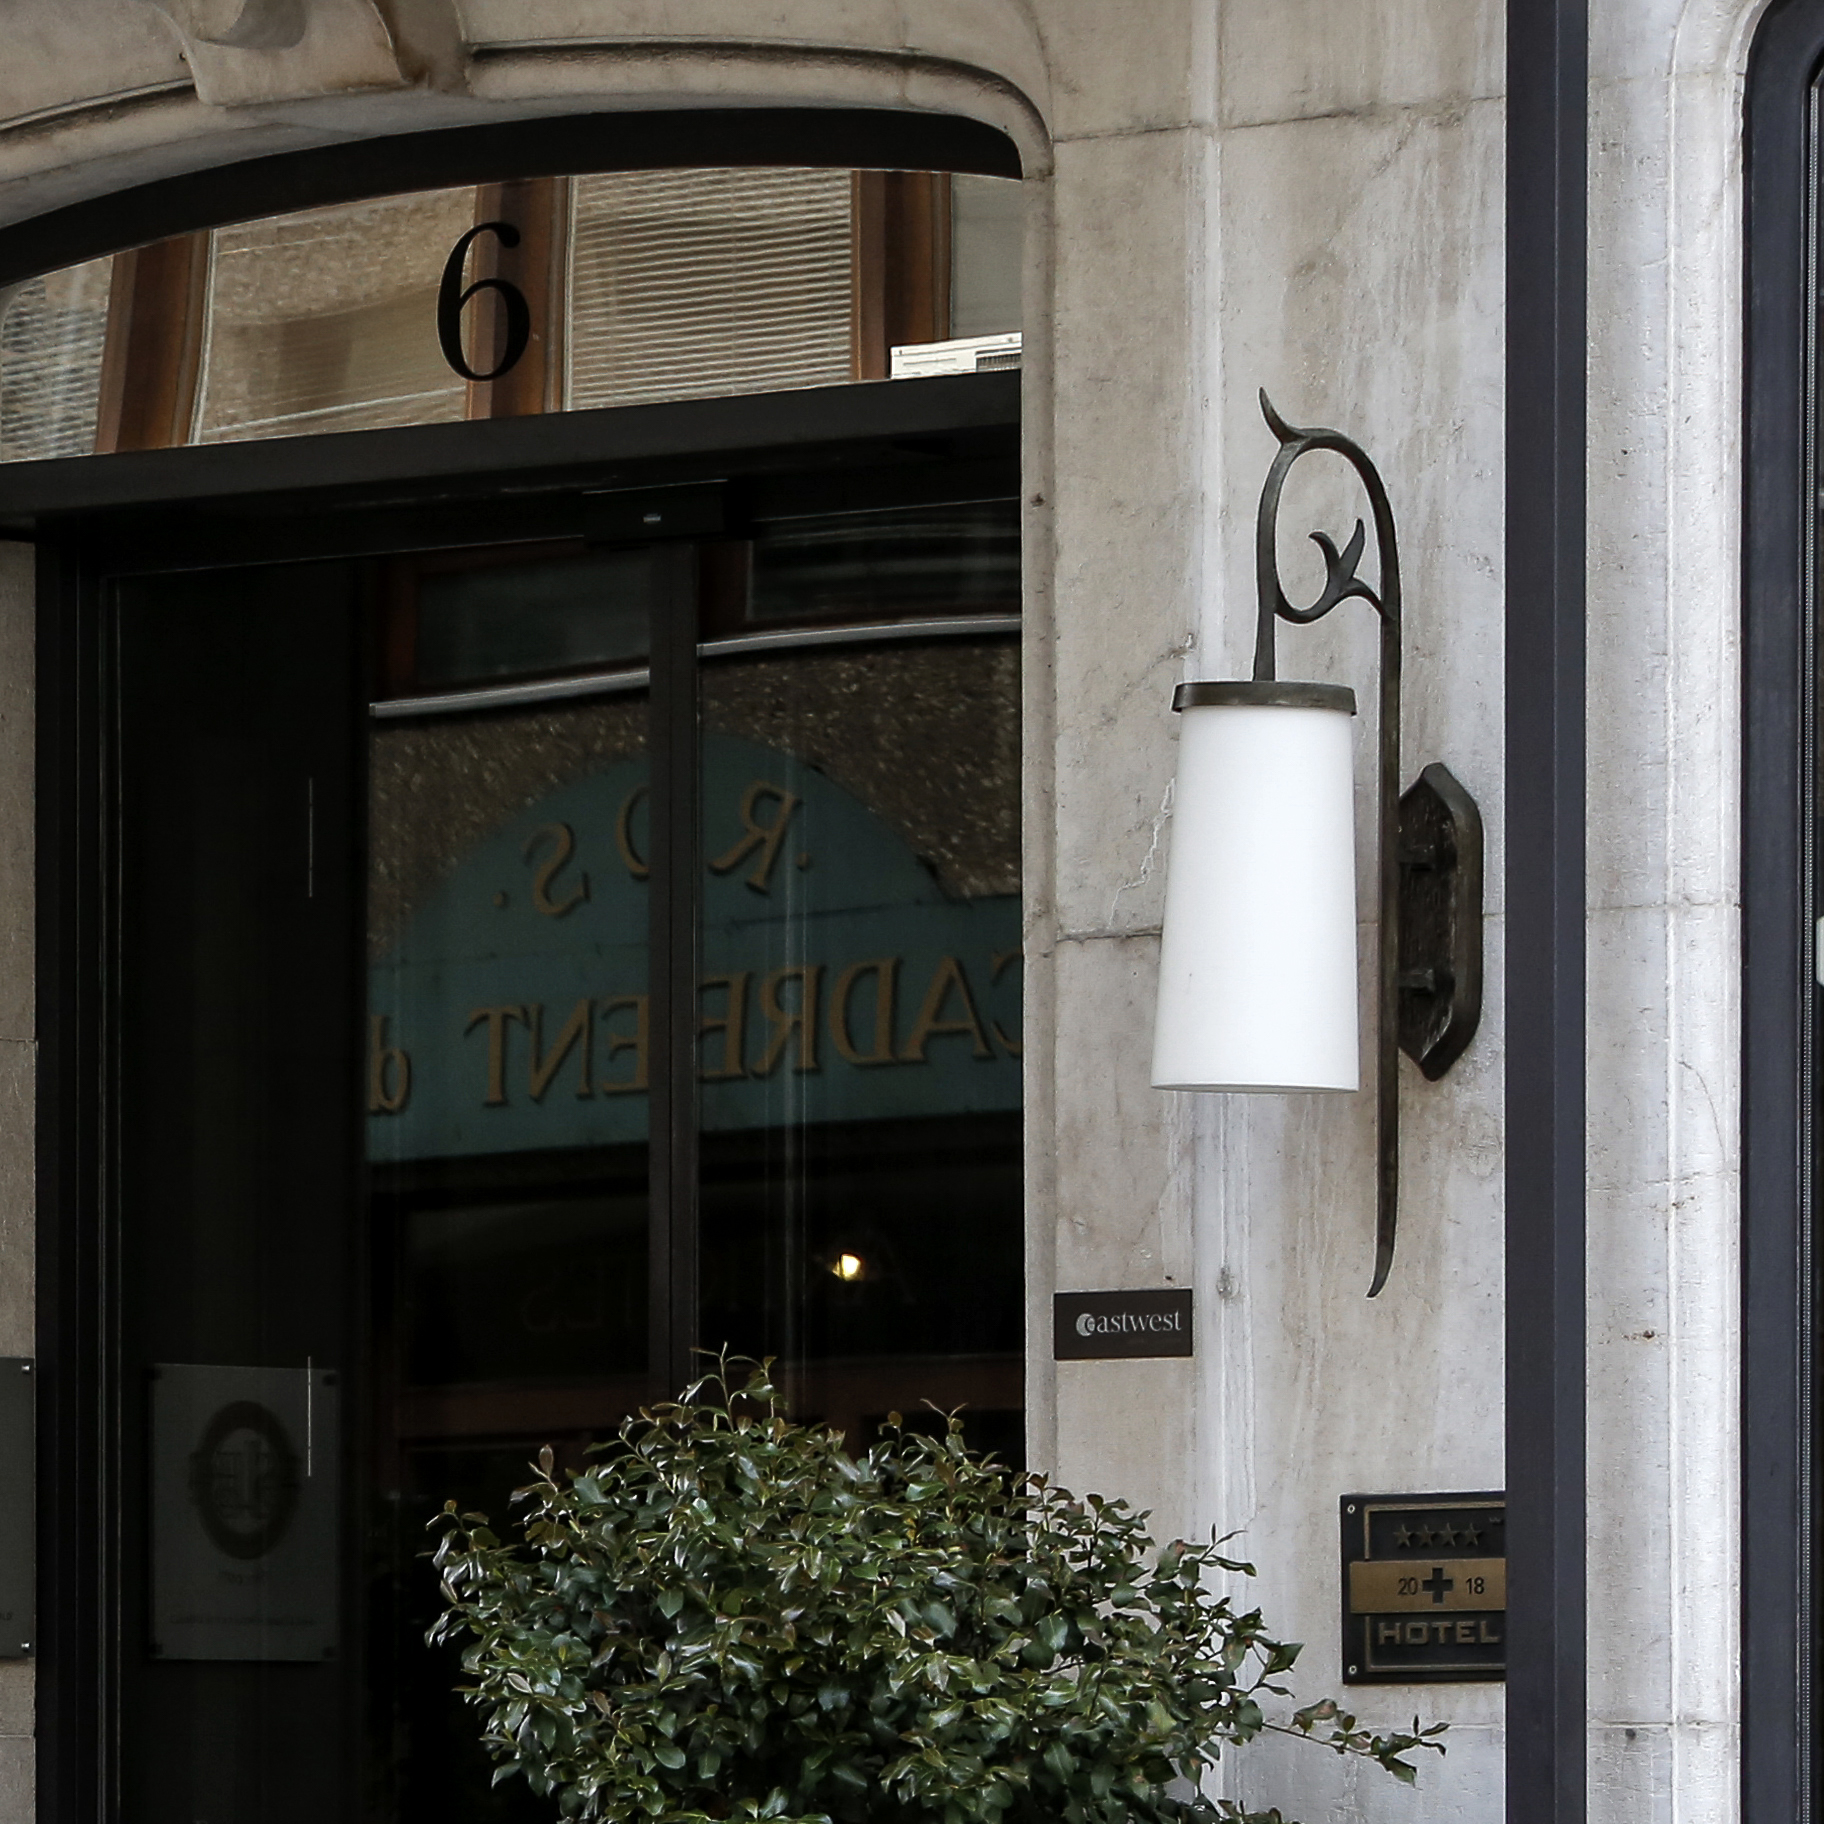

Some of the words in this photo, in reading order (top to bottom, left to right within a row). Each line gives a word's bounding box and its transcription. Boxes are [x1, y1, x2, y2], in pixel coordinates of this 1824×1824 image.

[435, 220, 531, 383] 6
[1076, 1310, 1182, 1337] eastwest
[1397, 1577, 1419, 1596] 20
[1465, 1577, 1485, 1595] 18
[1378, 1620, 1500, 1645] HOTEL
